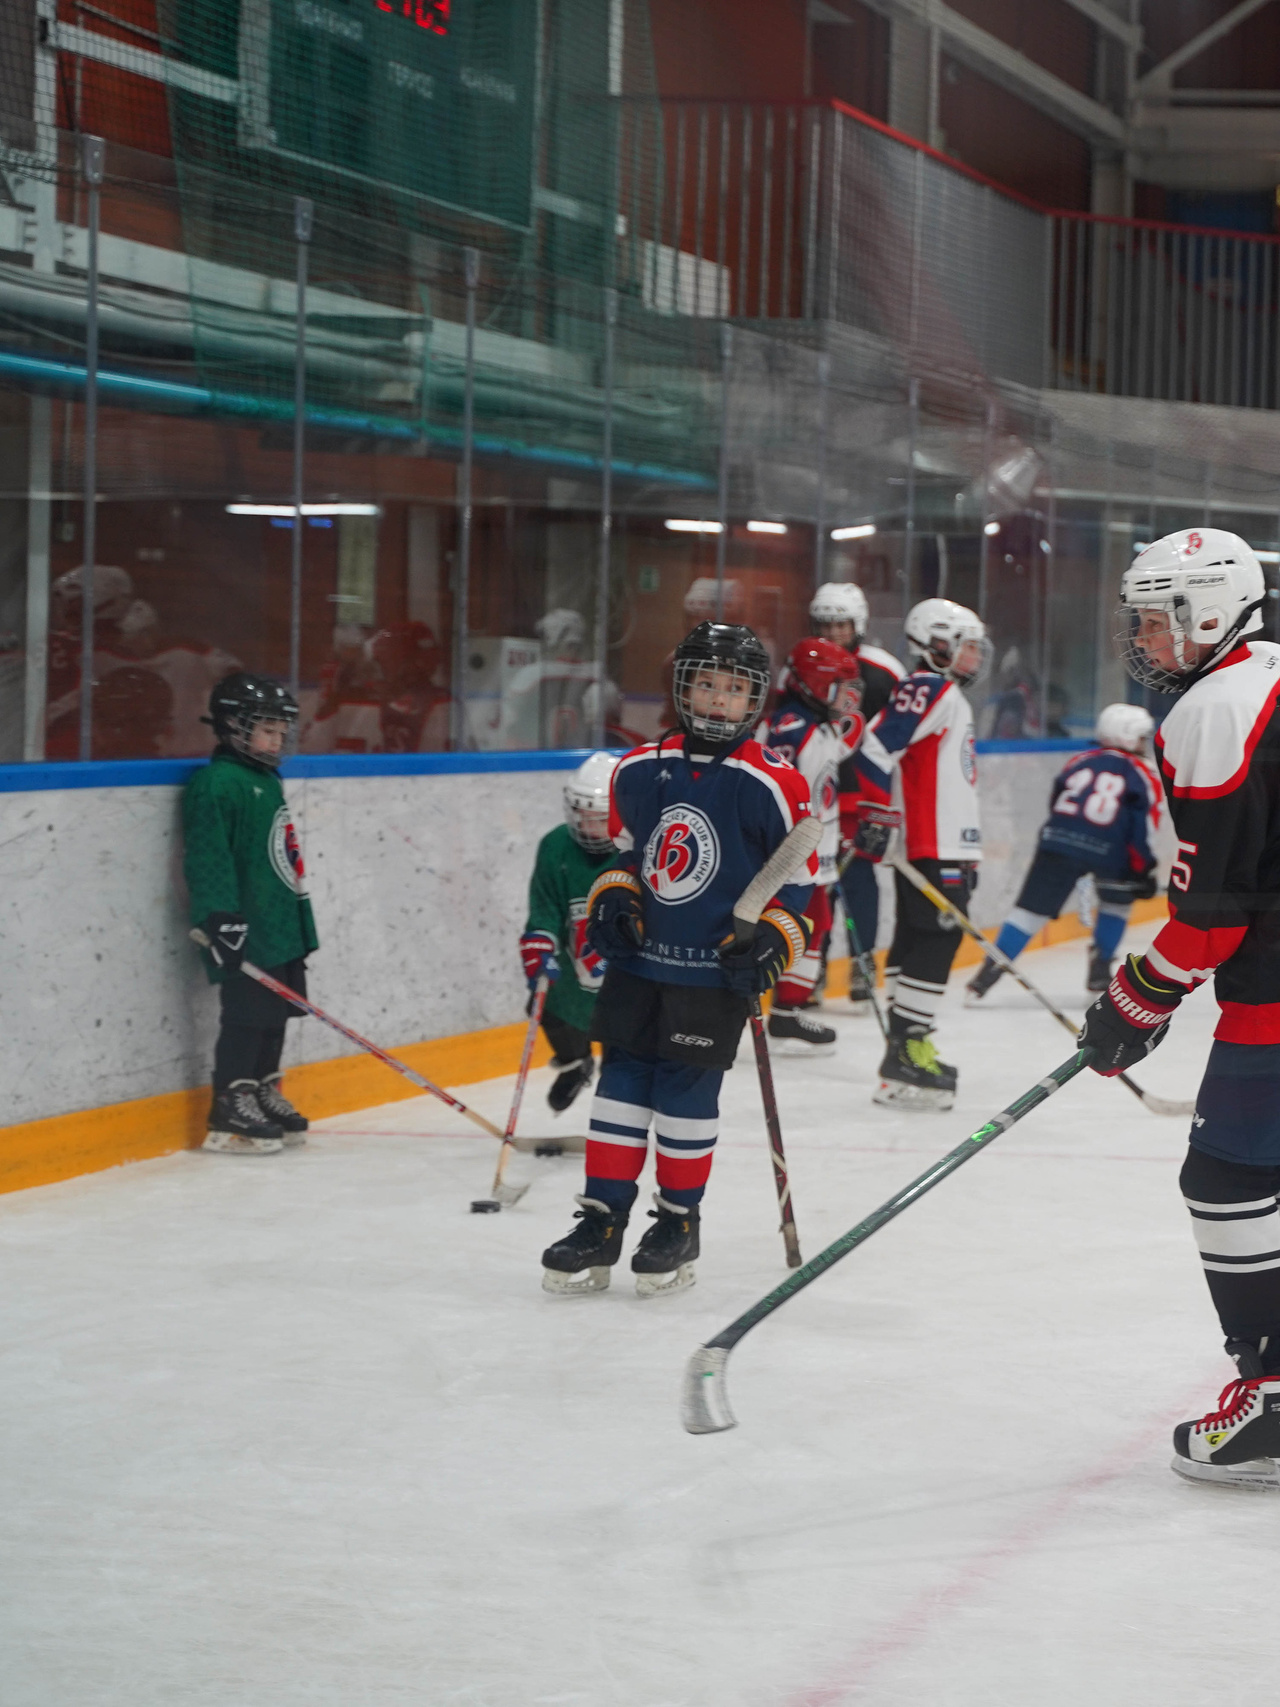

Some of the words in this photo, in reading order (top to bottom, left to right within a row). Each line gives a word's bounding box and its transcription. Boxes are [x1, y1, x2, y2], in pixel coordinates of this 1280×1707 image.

[1187, 576, 1226, 586] BAUER
[1053, 767, 1125, 826] 28
[689, 816, 708, 842] CLUB
[692, 849, 711, 883] VIKHR
